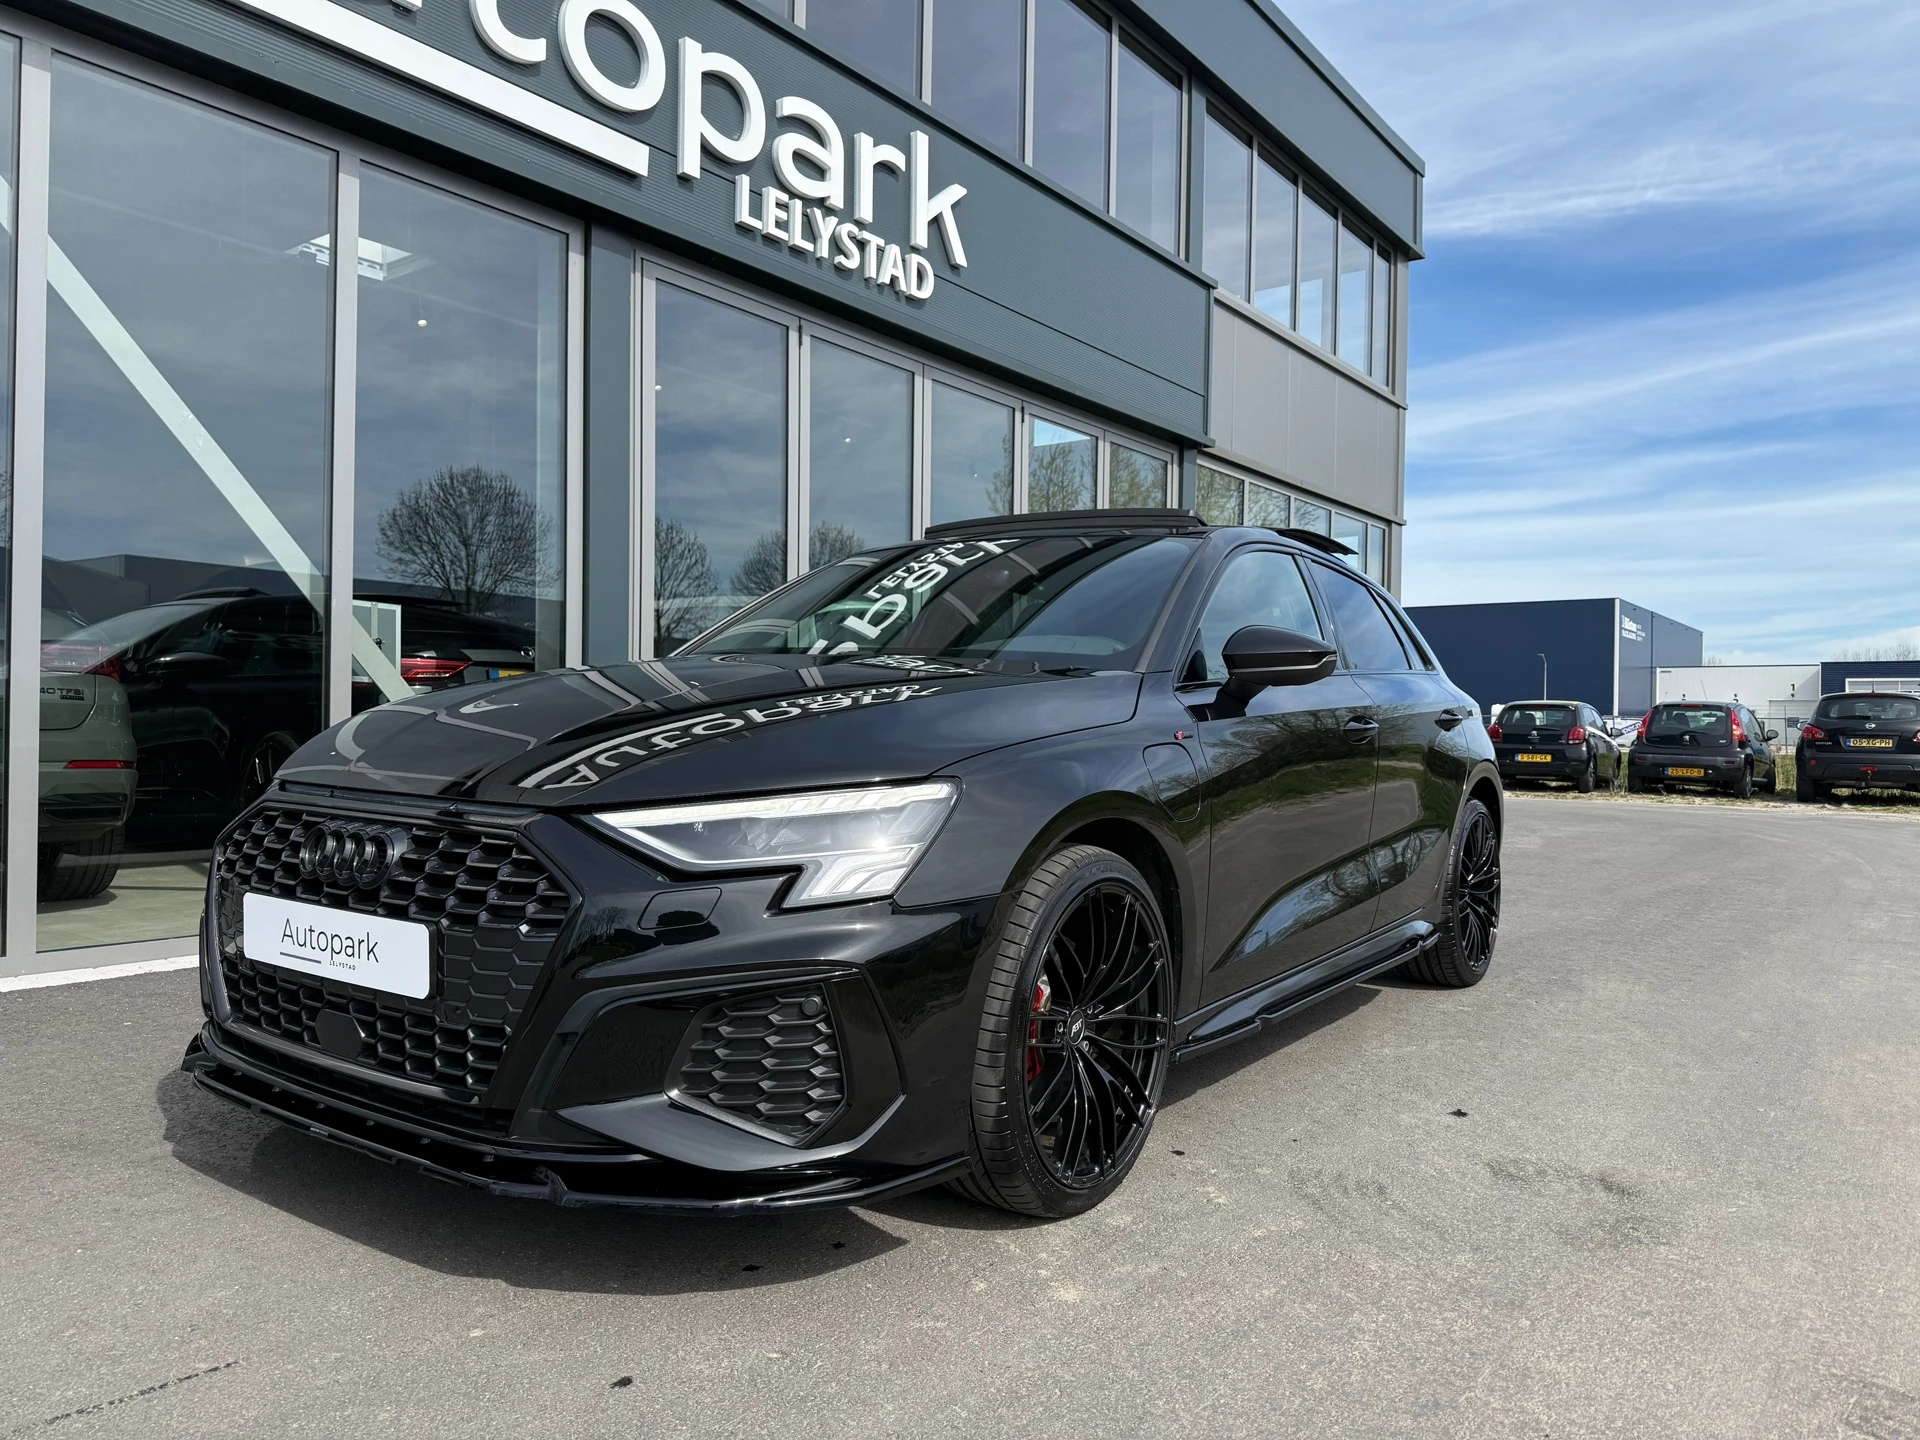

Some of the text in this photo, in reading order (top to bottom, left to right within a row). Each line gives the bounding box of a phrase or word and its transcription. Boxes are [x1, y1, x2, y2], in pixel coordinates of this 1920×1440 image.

[735, 173, 935, 300] LELYSTAD
[281, 917, 380, 964] Autopark
[329, 959, 356, 971] LELYSTAD
